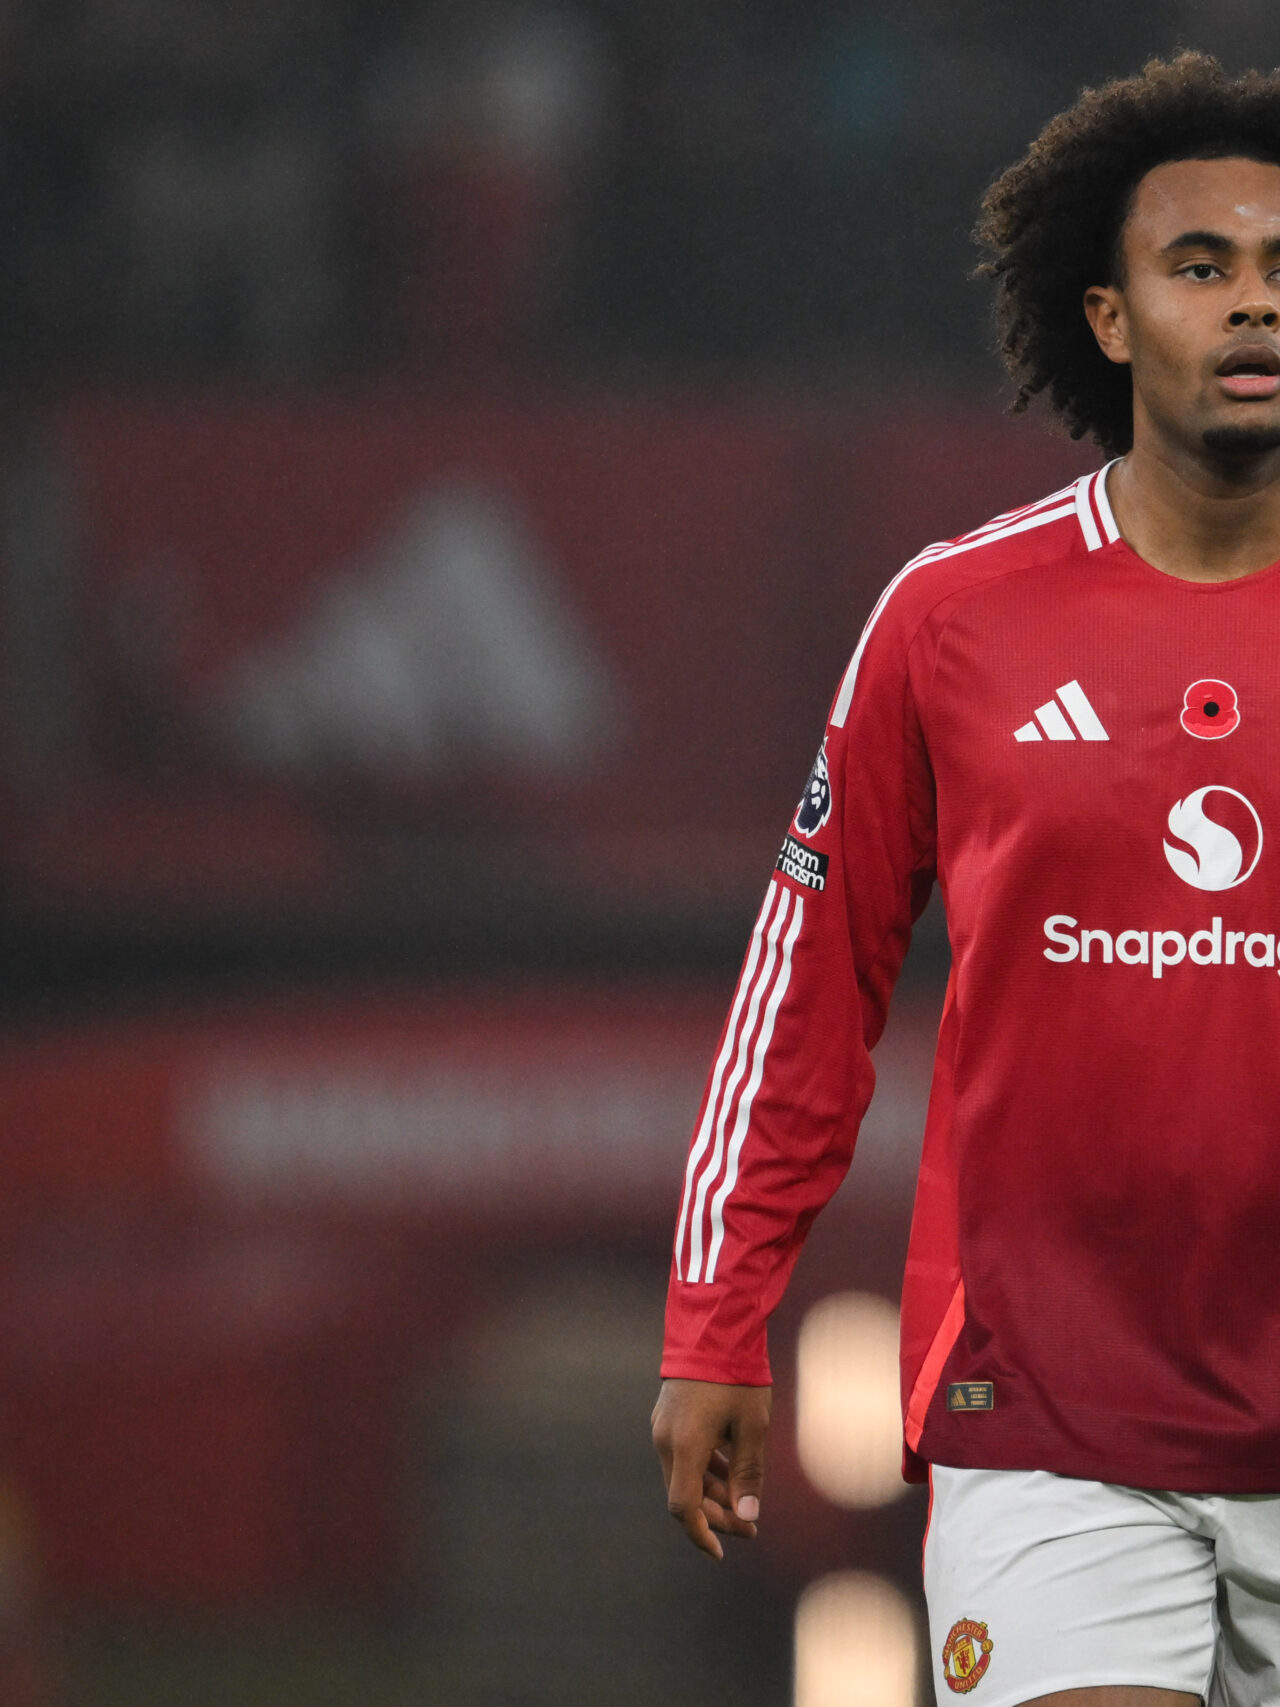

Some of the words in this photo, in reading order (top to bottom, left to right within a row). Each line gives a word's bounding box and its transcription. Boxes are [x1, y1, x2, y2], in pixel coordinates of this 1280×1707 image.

[787, 841, 819, 872] room
[943, 1623, 983, 1660] MANCHESTER
[954, 1666, 983, 1690] UNITED
